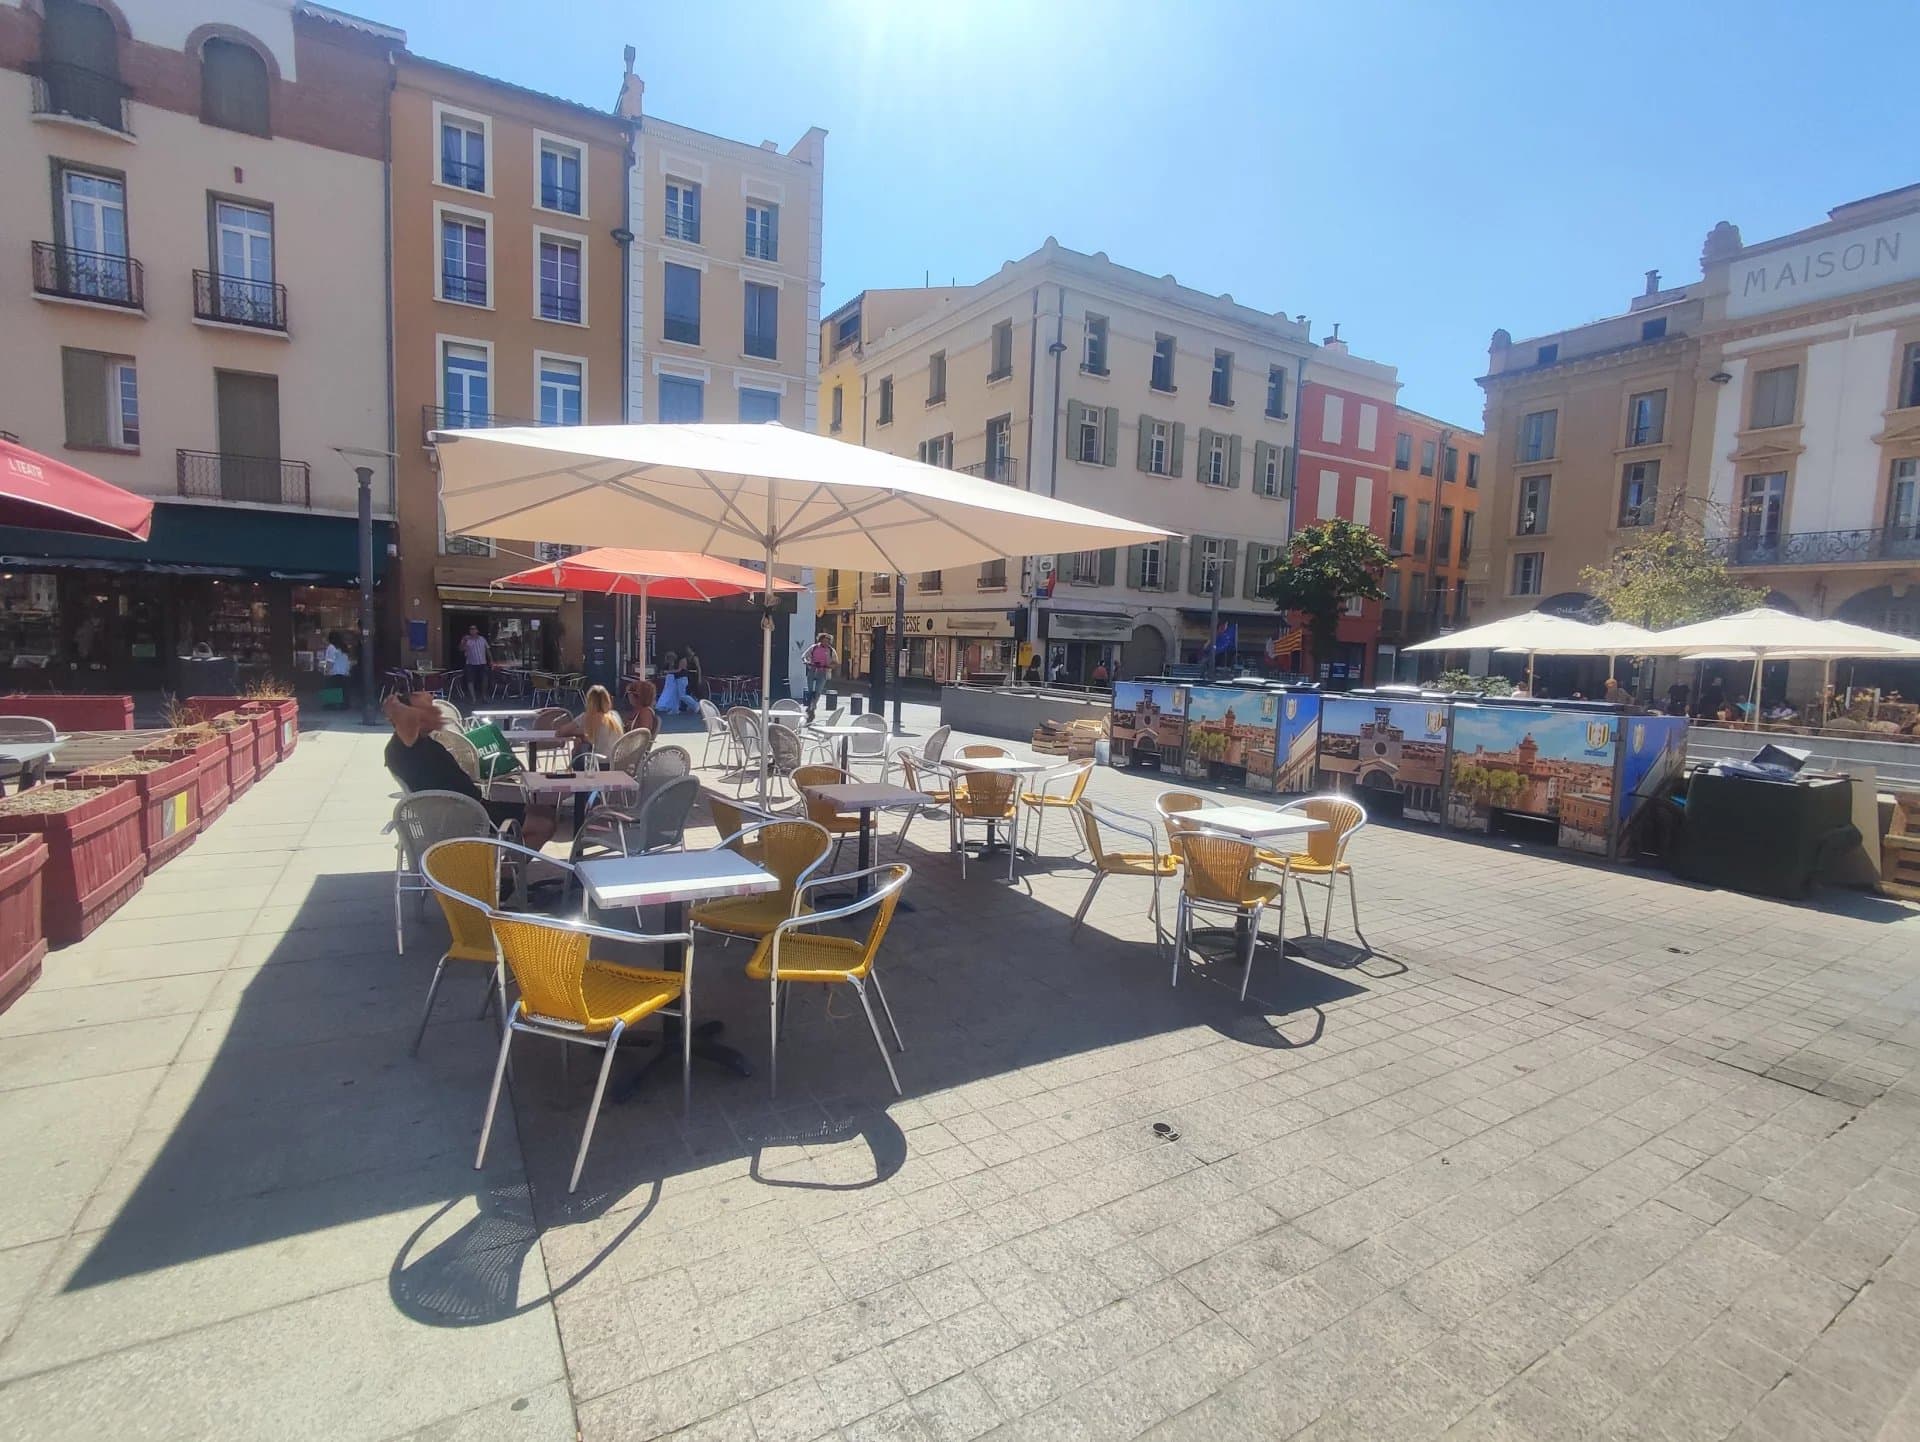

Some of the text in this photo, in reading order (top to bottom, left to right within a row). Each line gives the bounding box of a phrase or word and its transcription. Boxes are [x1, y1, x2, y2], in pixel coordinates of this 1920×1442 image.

[1744, 232, 1900, 297] MAISON
[903, 616, 920, 632] RESSE
[479, 743, 500, 757] RLIN
